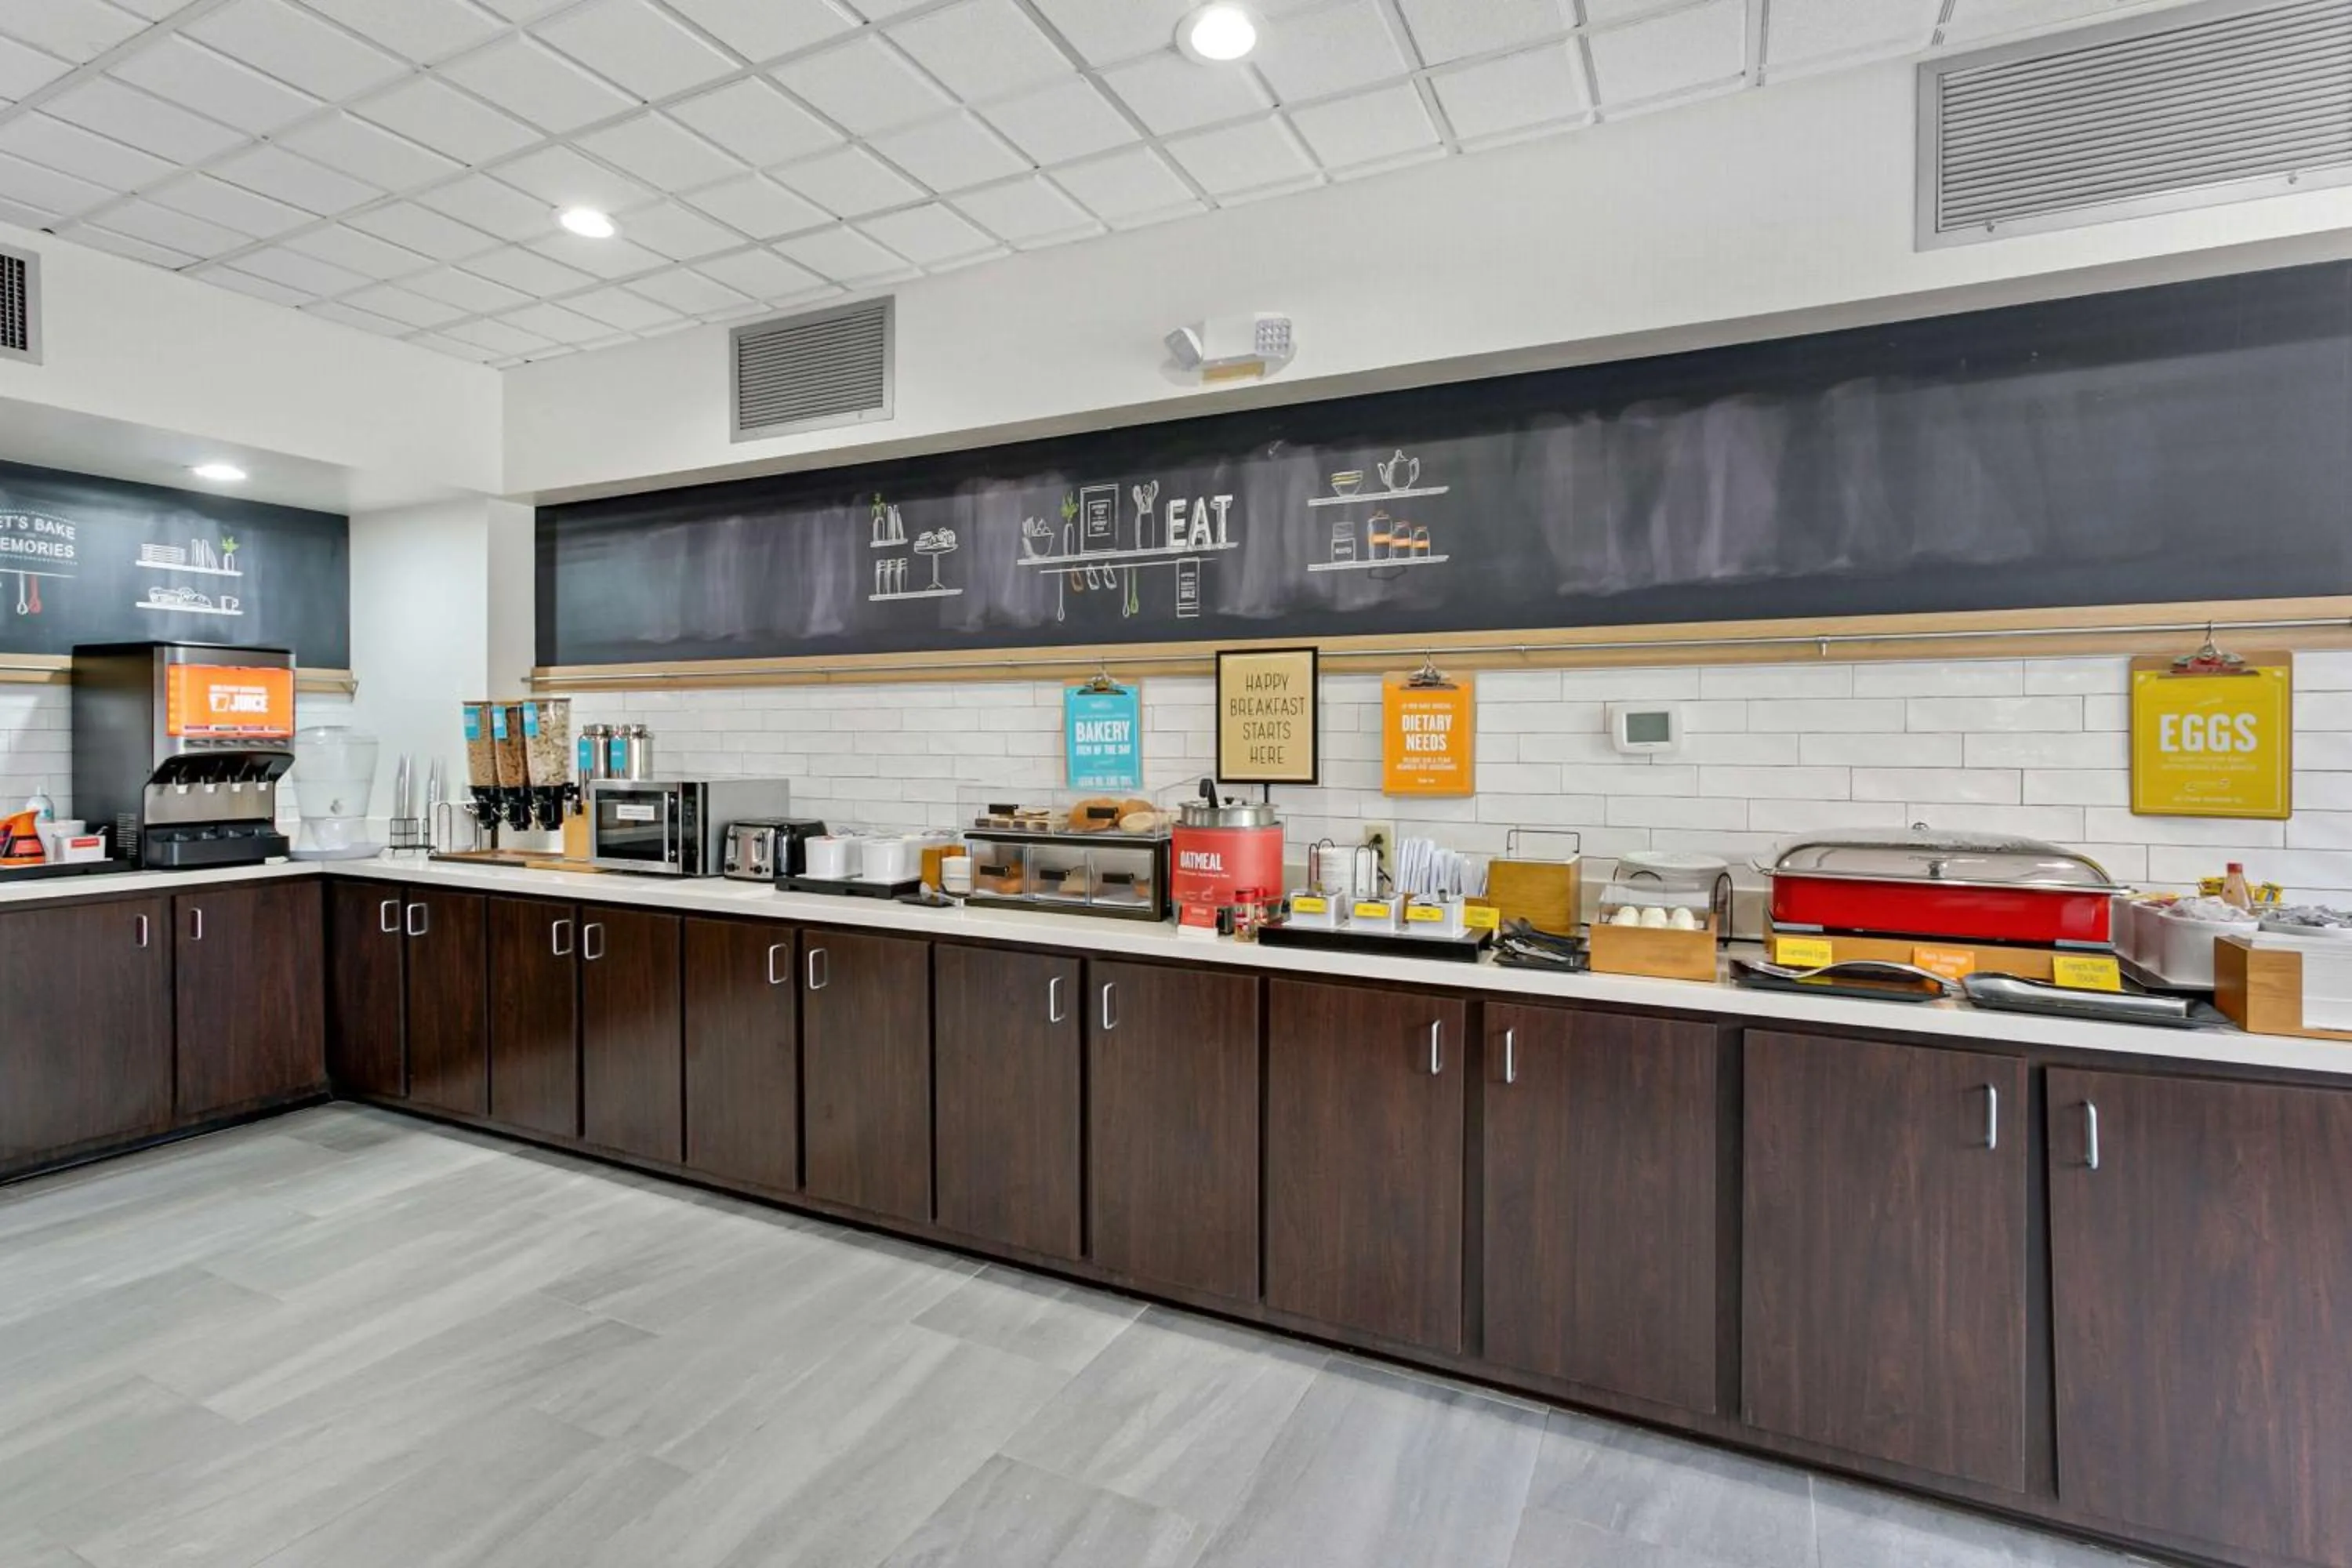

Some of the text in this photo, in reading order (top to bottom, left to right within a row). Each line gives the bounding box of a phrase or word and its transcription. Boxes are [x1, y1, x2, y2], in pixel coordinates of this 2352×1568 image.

[34, 518, 75, 540] BAKE
[1165, 494, 1233, 547] EAT
[0, 537, 74, 558] EMORIES
[1245, 673, 1290, 691] HAPPY
[1229, 696, 1305, 717] BREAKFAST
[1075, 720, 1131, 742] BAKERY
[1242, 720, 1291, 741] STARTS
[1401, 713, 1453, 731] DIETARY
[1406, 733, 1447, 752] NEEDS
[2159, 713, 2258, 753] EGGS
[1250, 746, 1286, 765] HERE
[1180, 850, 1224, 871] OATMEAL
